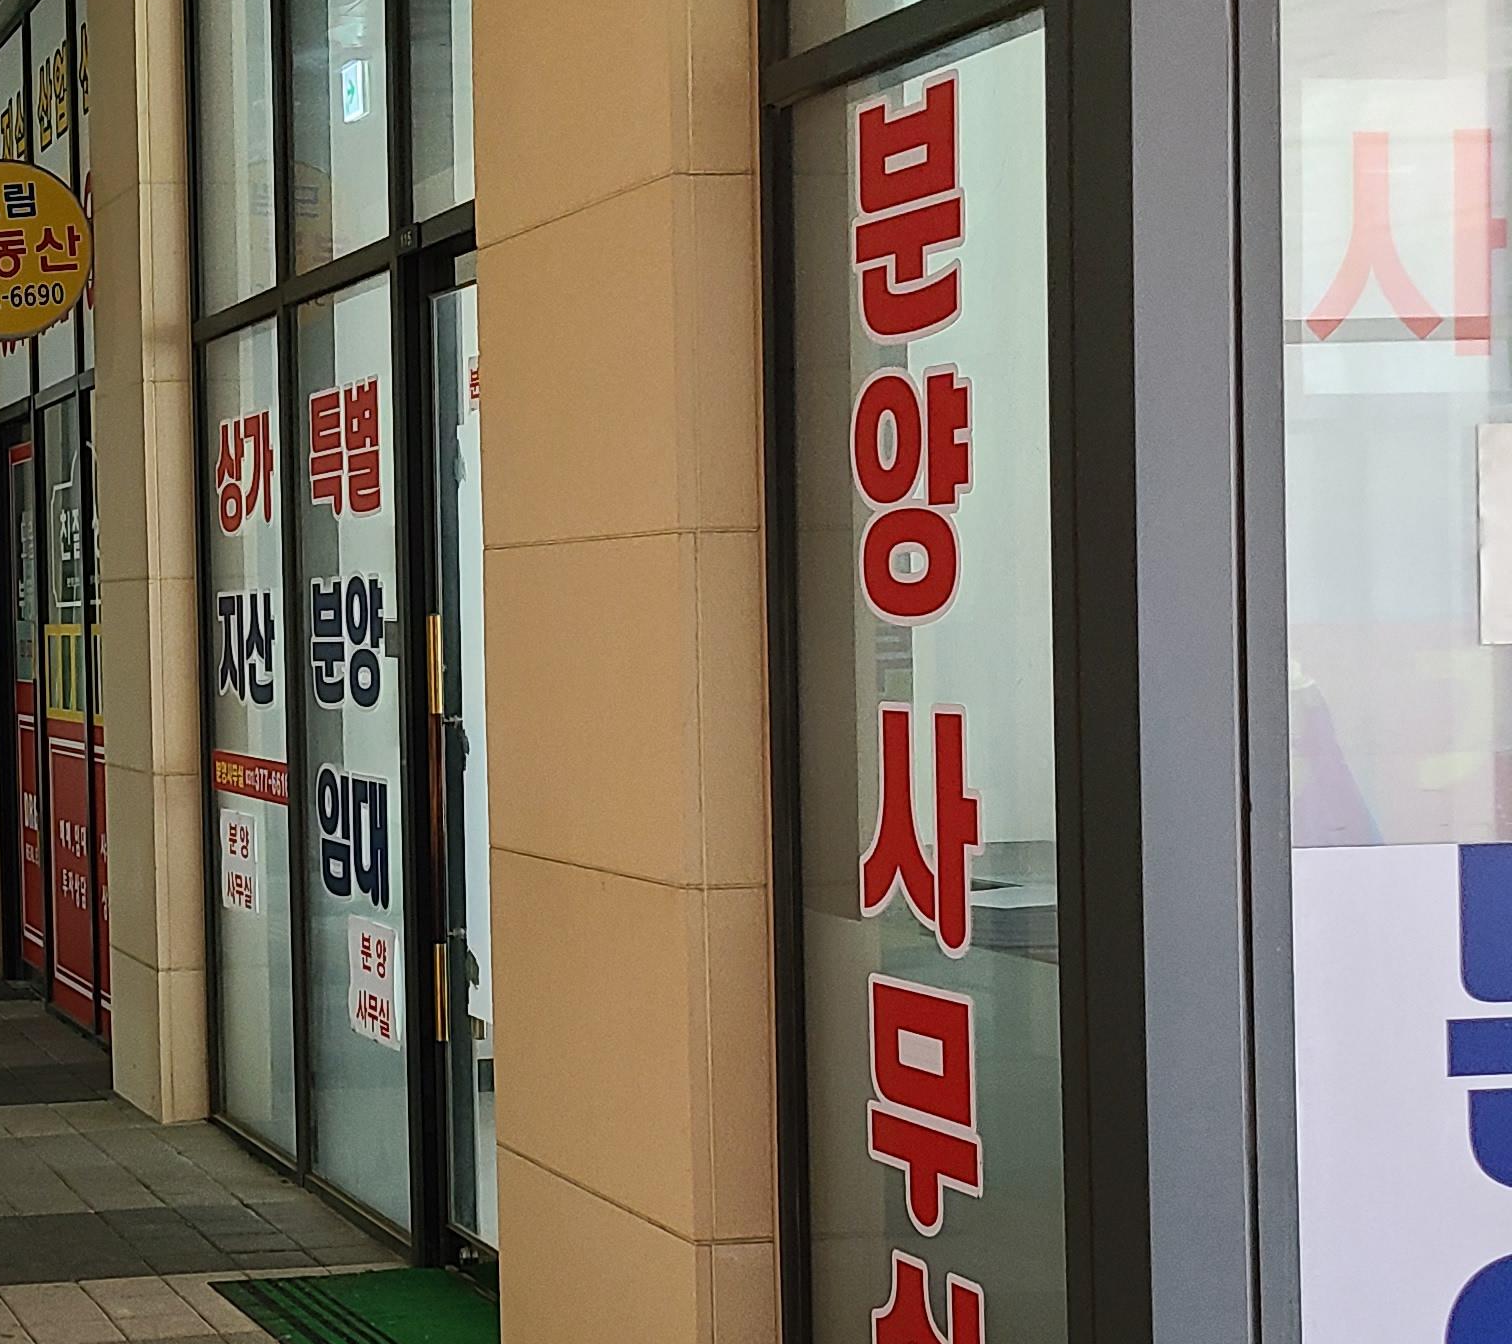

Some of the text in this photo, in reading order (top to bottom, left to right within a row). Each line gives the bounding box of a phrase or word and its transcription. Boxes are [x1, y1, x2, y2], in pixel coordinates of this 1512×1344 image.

[217, 376, 382, 533] 상가 특별
[218, 574, 384, 707] 지산 분양
[228, 822, 250, 859] 분양
[317, 766, 389, 911] 임대
[227, 871, 252, 910] 사무실
[360, 932, 387, 979] 분양
[356, 989, 391, 1040] 사무실
